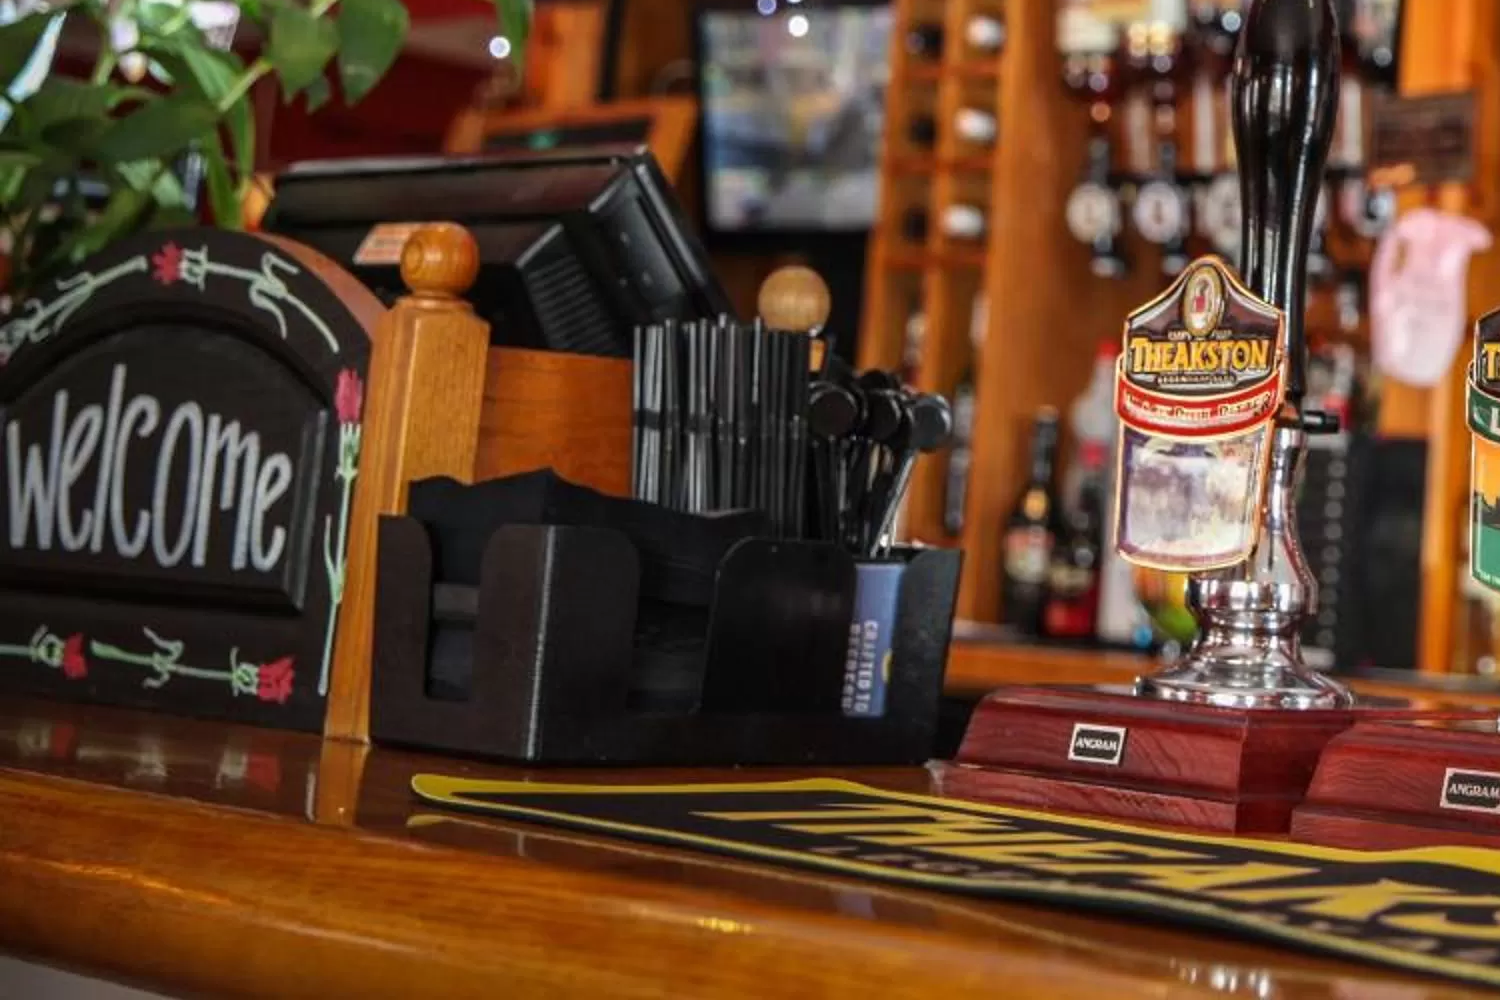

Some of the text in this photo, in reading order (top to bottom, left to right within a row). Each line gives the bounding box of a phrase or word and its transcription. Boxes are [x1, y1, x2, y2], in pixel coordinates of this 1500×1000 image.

[1130, 337, 1270, 374] THEAKSTON
[1075, 737, 1118, 752] ANGRAM
[1448, 781, 1500, 800] ANGRAM
